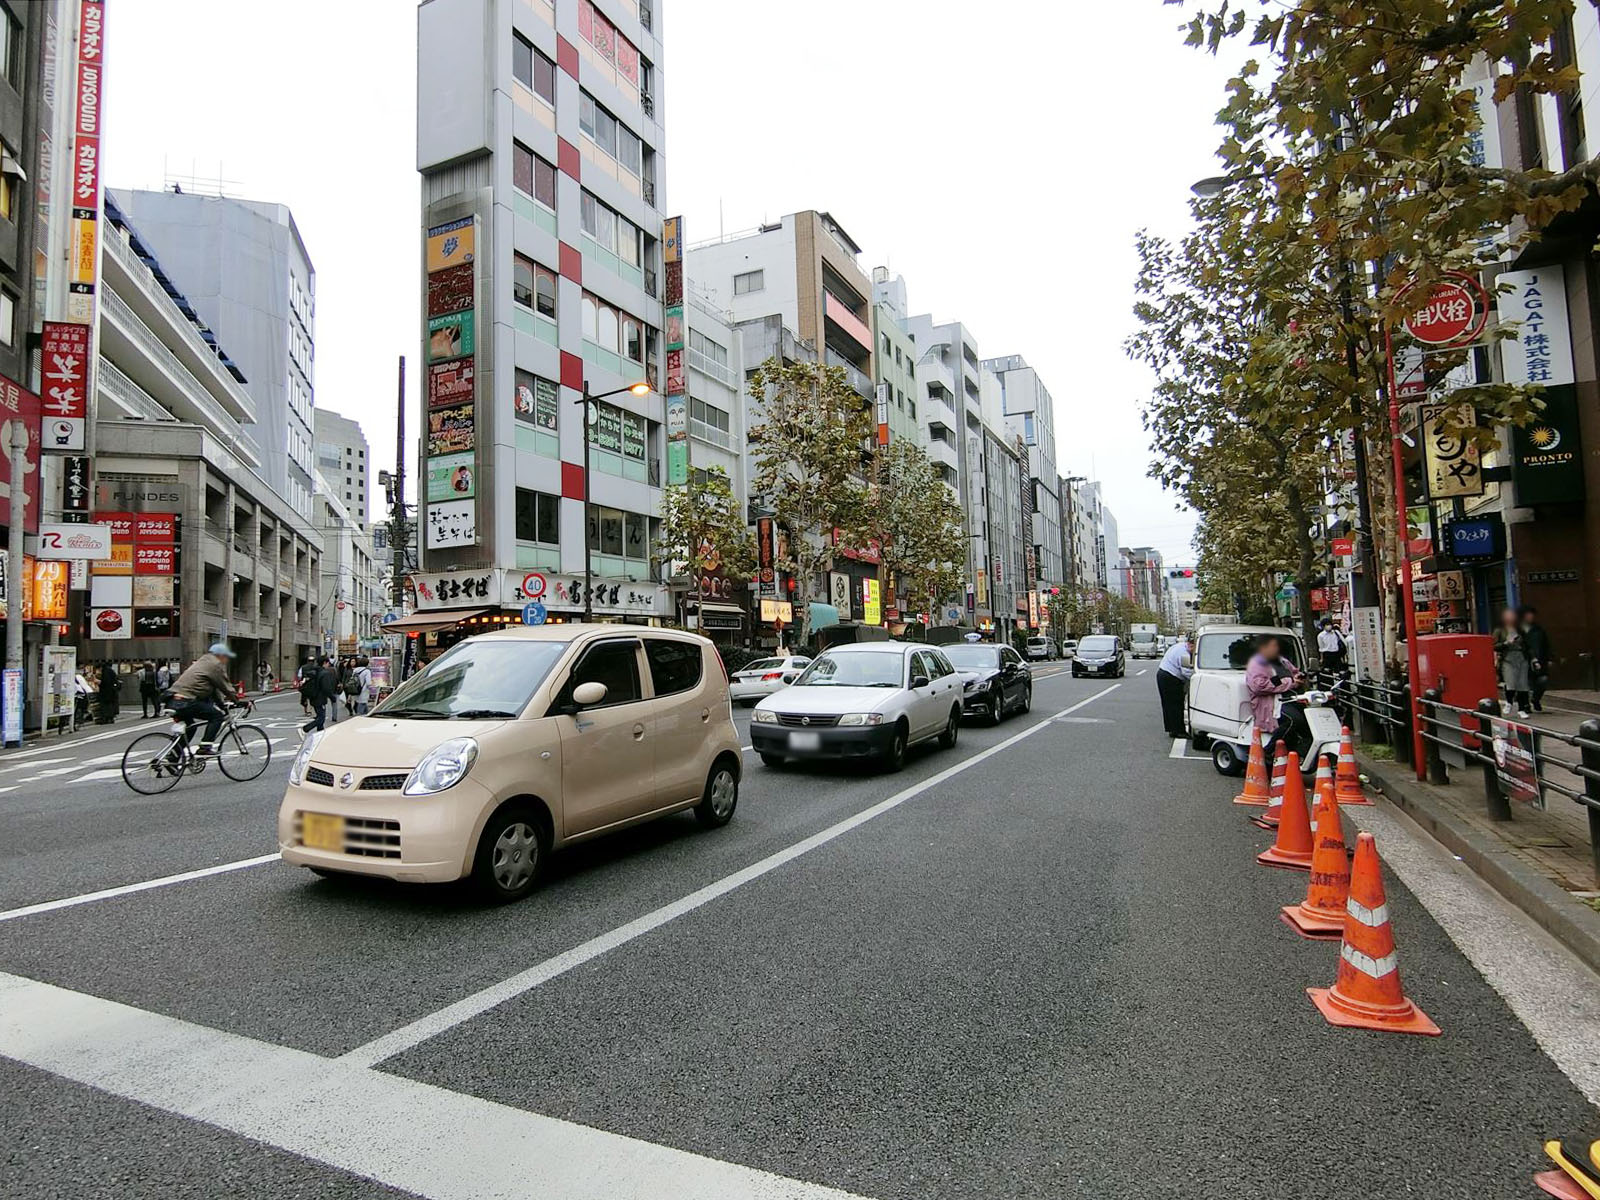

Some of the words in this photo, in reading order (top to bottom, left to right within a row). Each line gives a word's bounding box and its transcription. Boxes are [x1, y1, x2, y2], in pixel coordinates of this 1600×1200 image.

[82, 7, 101, 60] カラオケ
[80, 66, 98, 134] JOYSOUND
[77, 144, 96, 199] カラオケ
[77, 284, 88, 293] 4F
[1411, 298, 1468, 329] 消火栓
[1523, 275, 1553, 382] JAGAT株式会社
[1522, 452, 1573, 465] PRONTO
[113, 492, 180, 502] FUNDES
[138, 521, 172, 529] カラオケ
[137, 549, 172, 558] カラオケ
[36, 561, 60, 581] 29
[435, 574, 492, 602] 富士そば
[528, 579, 541, 591] 40
[38, 611, 63, 619] B1F
[527, 607, 537, 625] P
